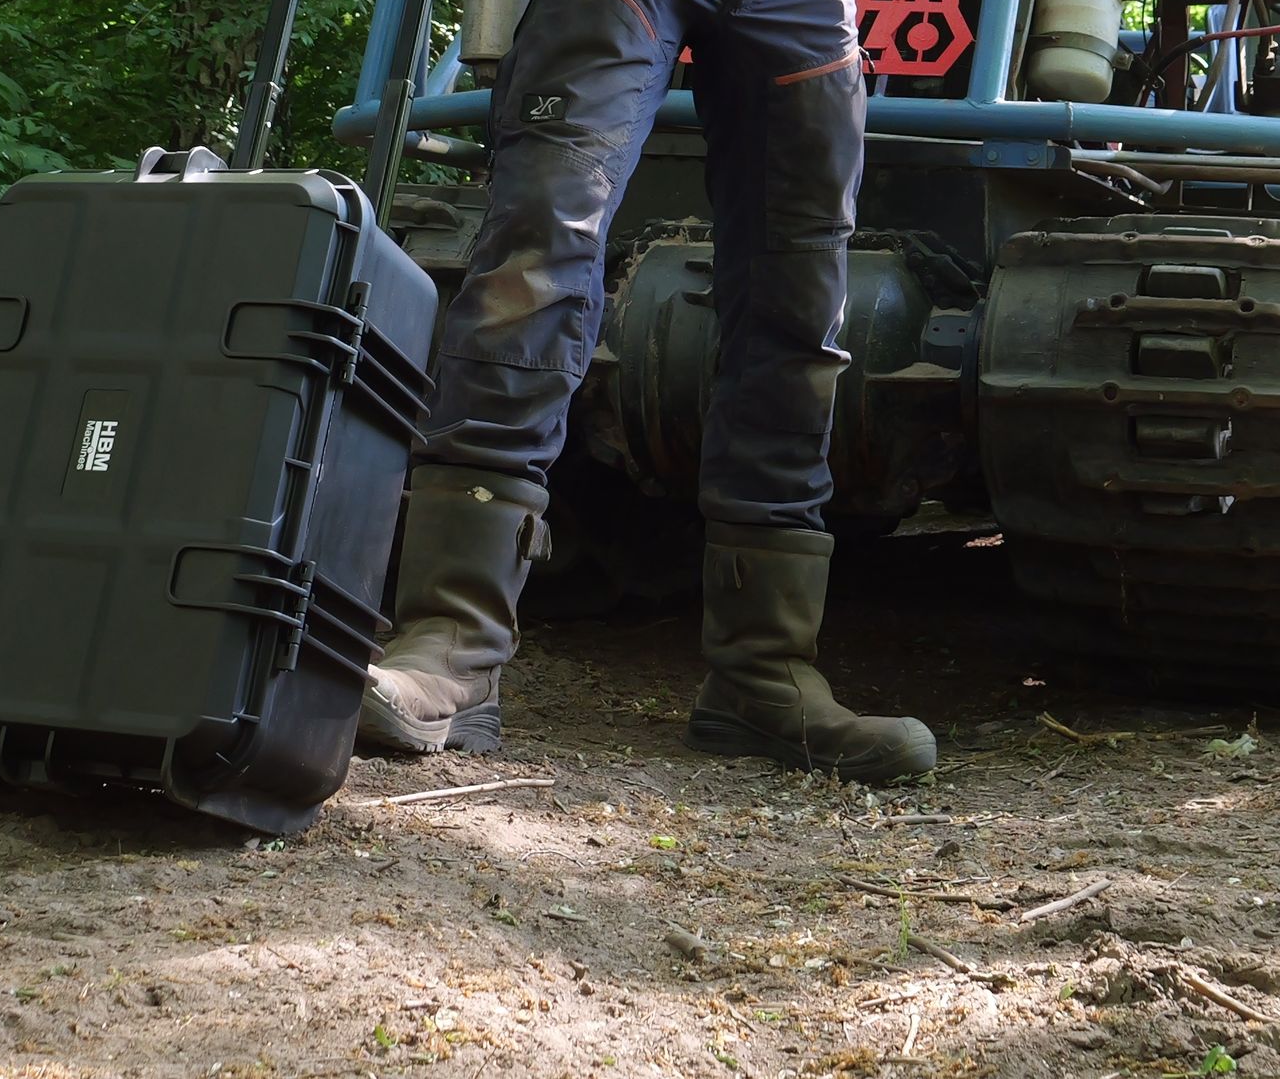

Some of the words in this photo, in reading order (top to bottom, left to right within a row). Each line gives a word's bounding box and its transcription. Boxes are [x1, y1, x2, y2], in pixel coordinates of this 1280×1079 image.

[858, 10, 955, 62] LO
[76, 420, 96, 470] Machines
[92, 421, 119, 471] HBM
